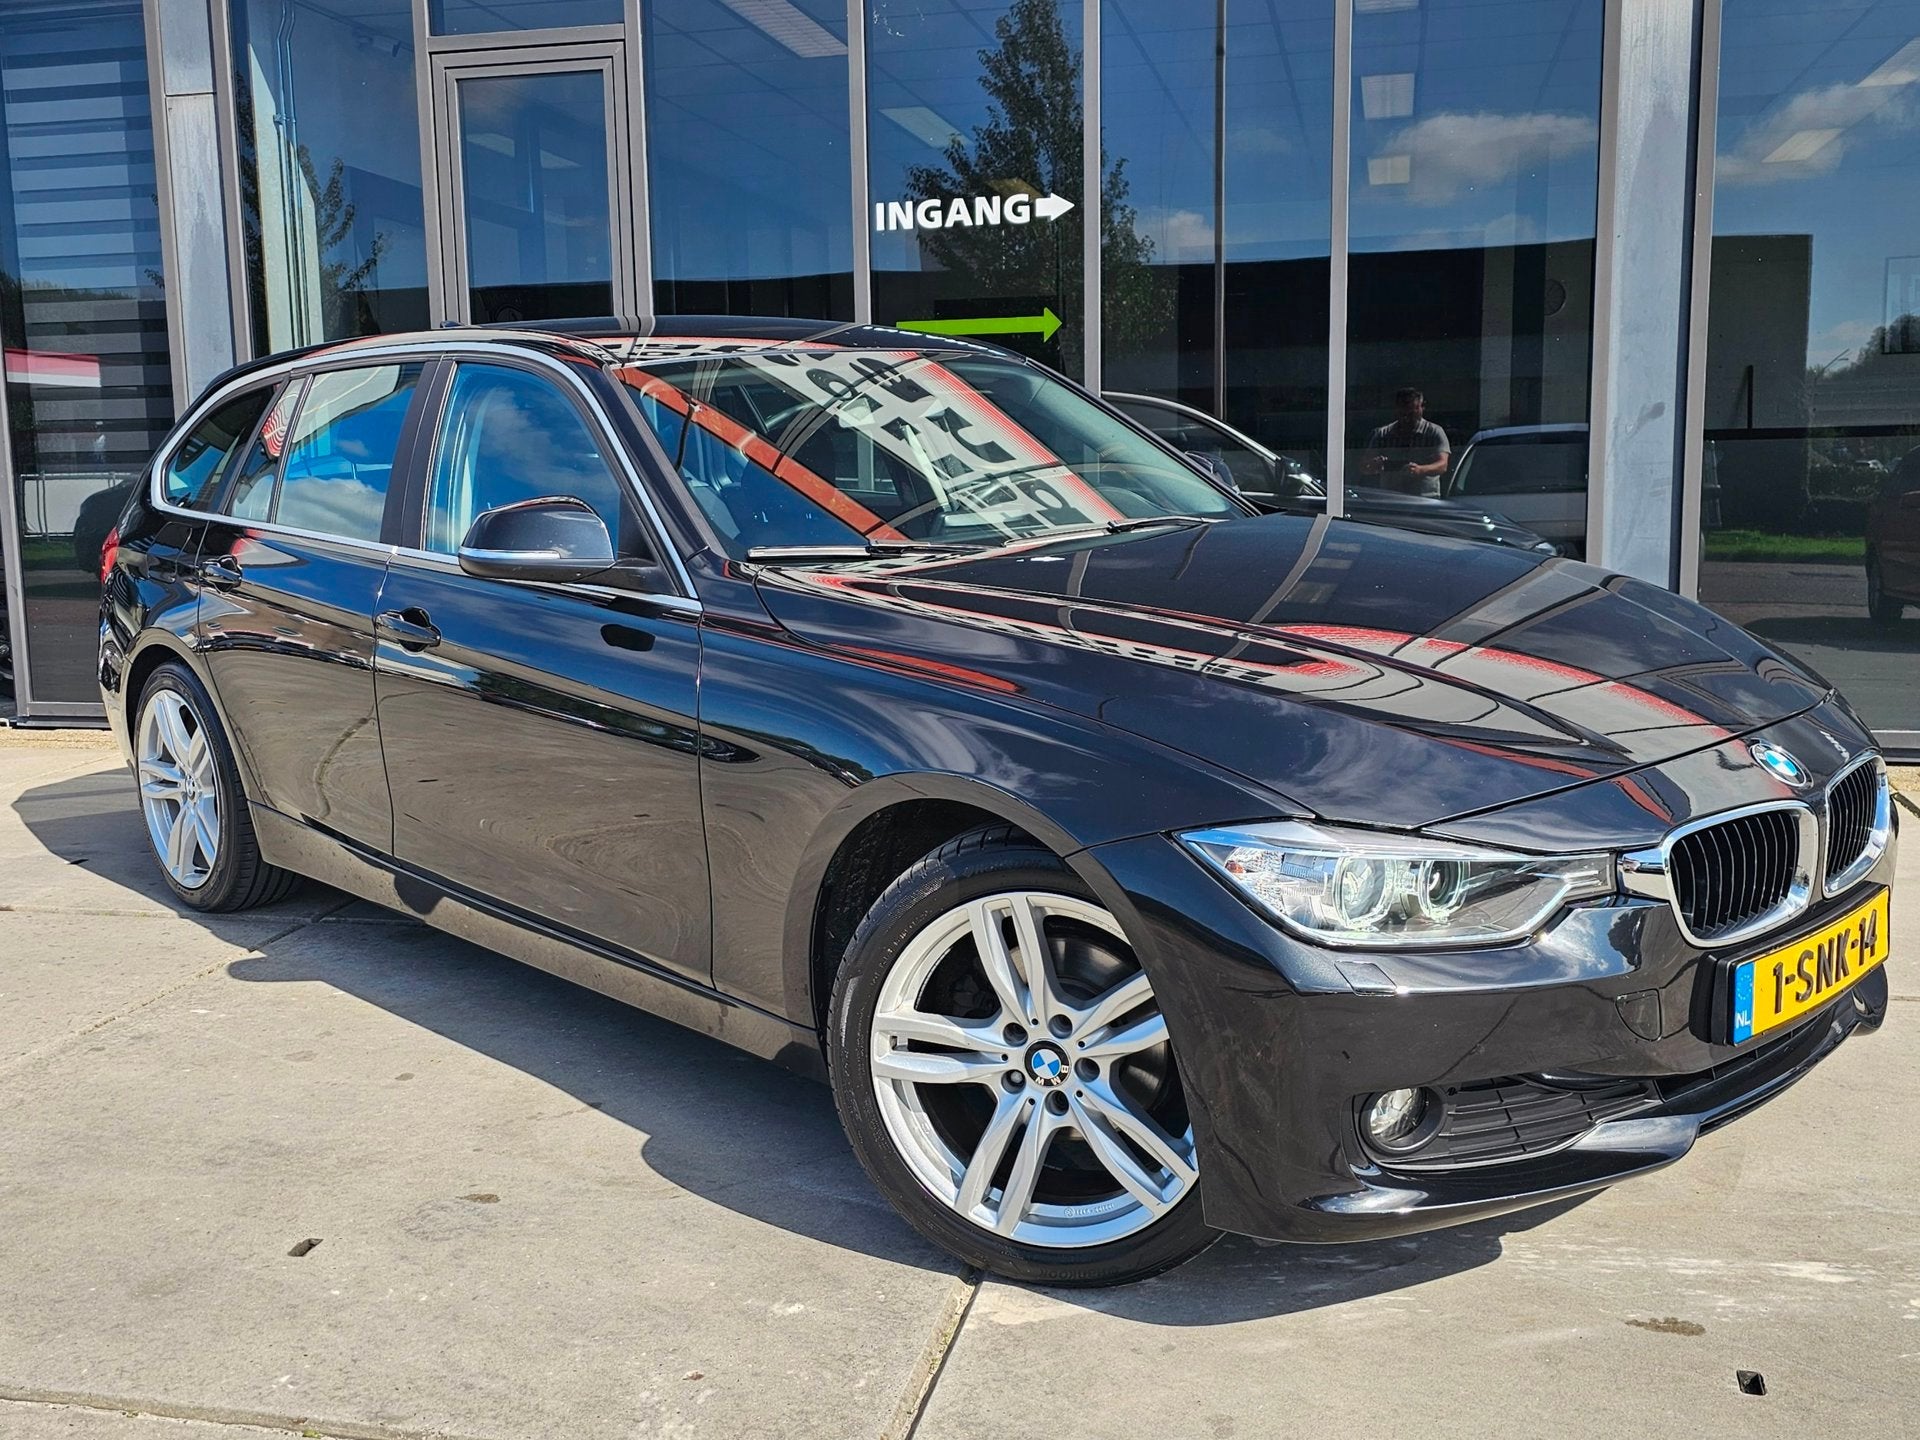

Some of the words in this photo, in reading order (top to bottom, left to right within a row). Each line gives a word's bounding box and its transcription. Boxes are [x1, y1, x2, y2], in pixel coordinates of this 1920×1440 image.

[875, 193, 1031, 232] INGANG
[1773, 909, 1877, 1015] 1-SNK-14
[1735, 1012, 1751, 1029] NL
